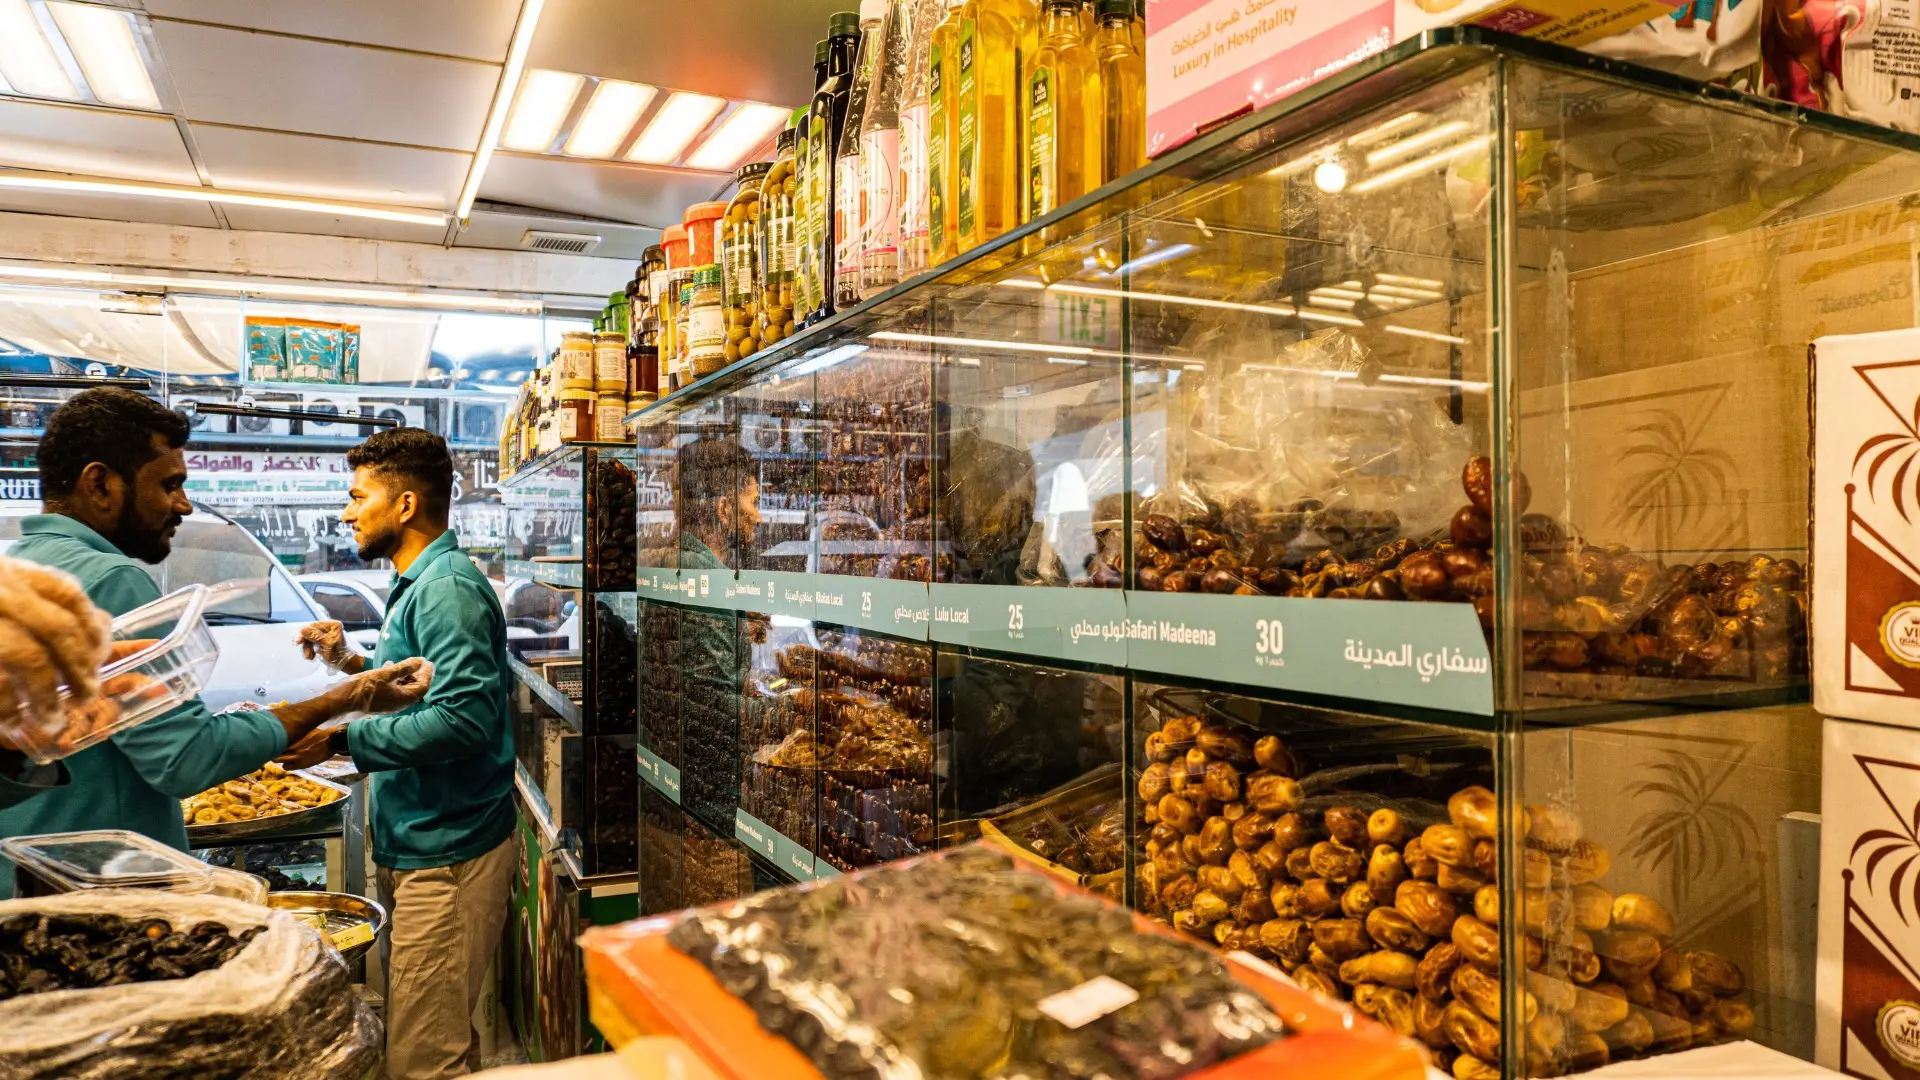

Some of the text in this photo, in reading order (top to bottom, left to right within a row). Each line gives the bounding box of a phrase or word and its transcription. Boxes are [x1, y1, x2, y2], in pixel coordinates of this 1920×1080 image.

[1173, 51, 1211, 78] Luxury
[1214, 41, 1225, 59] in
[1227, 6, 1297, 53] Hospitality
[187, 455, 253, 473] والفواك
[861, 591, 872, 612] 25
[934, 606, 969, 624] Lulu Local
[1008, 604, 1024, 630] 25
[1070, 619, 1100, 644] محلي
[1160, 622, 1216, 646] Madeena
[1255, 618, 1284, 655] 30
[1344, 640, 1488, 682] سفاري المدينة
